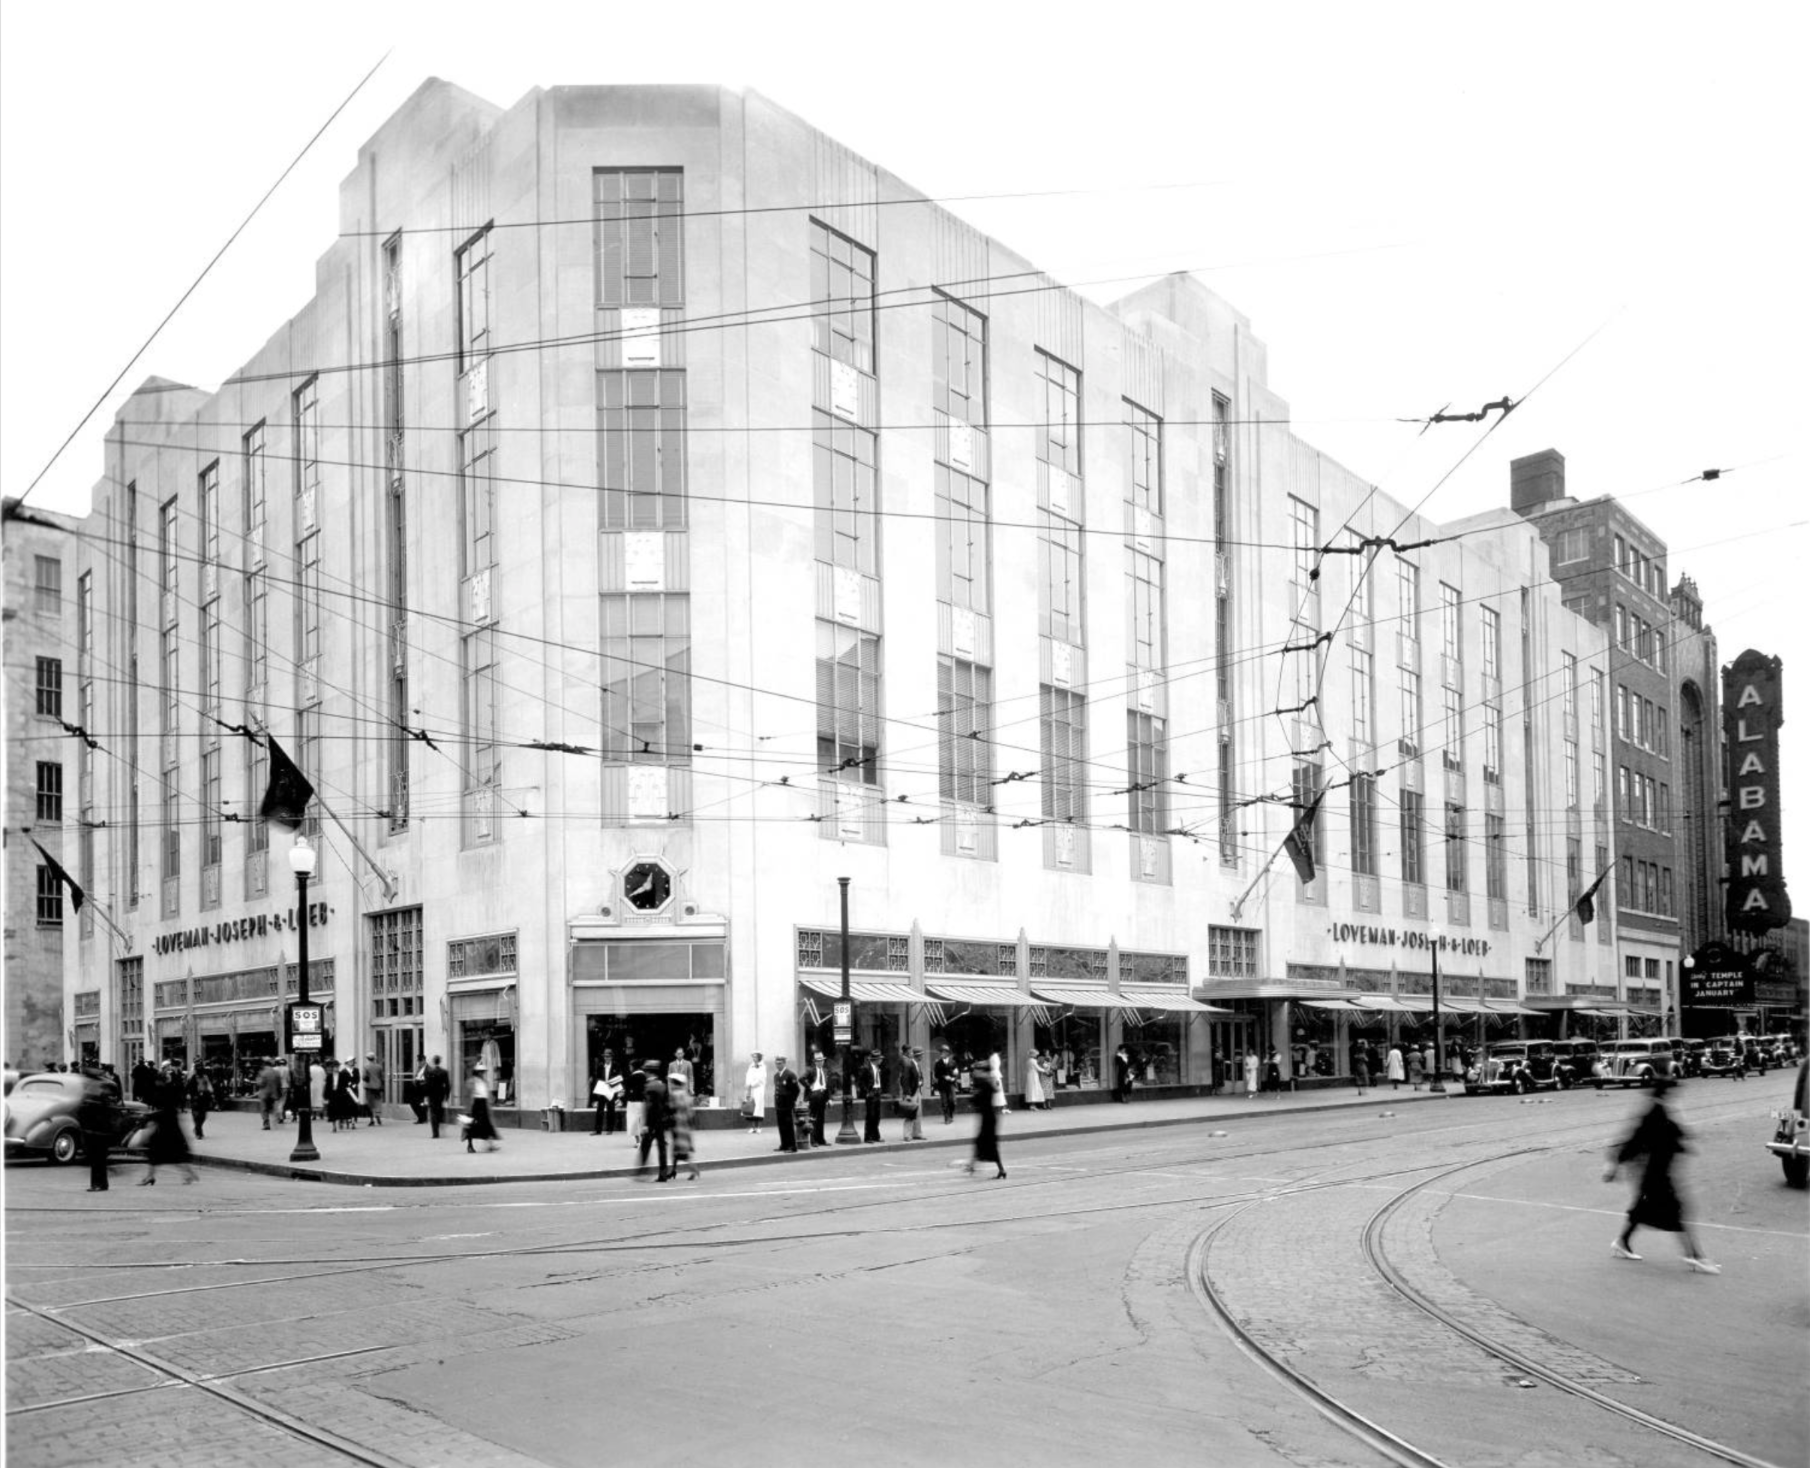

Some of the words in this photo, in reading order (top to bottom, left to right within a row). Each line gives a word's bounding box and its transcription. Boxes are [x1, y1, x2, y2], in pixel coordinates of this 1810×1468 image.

[1737, 684, 1769, 911] ALABAMA
[155, 926, 209, 956] LOVEMAN
[214, 914, 267, 944] JOSEPH
[288, 901, 328, 931] LEB
[1333, 922, 1396, 946] LOVEMAN
[1401, 930, 1447, 952] JOSEH
[1462, 937, 1488, 957] LOEB
[294, 1011, 318, 1020] SOS
[834, 1006, 850, 1014] SOS
